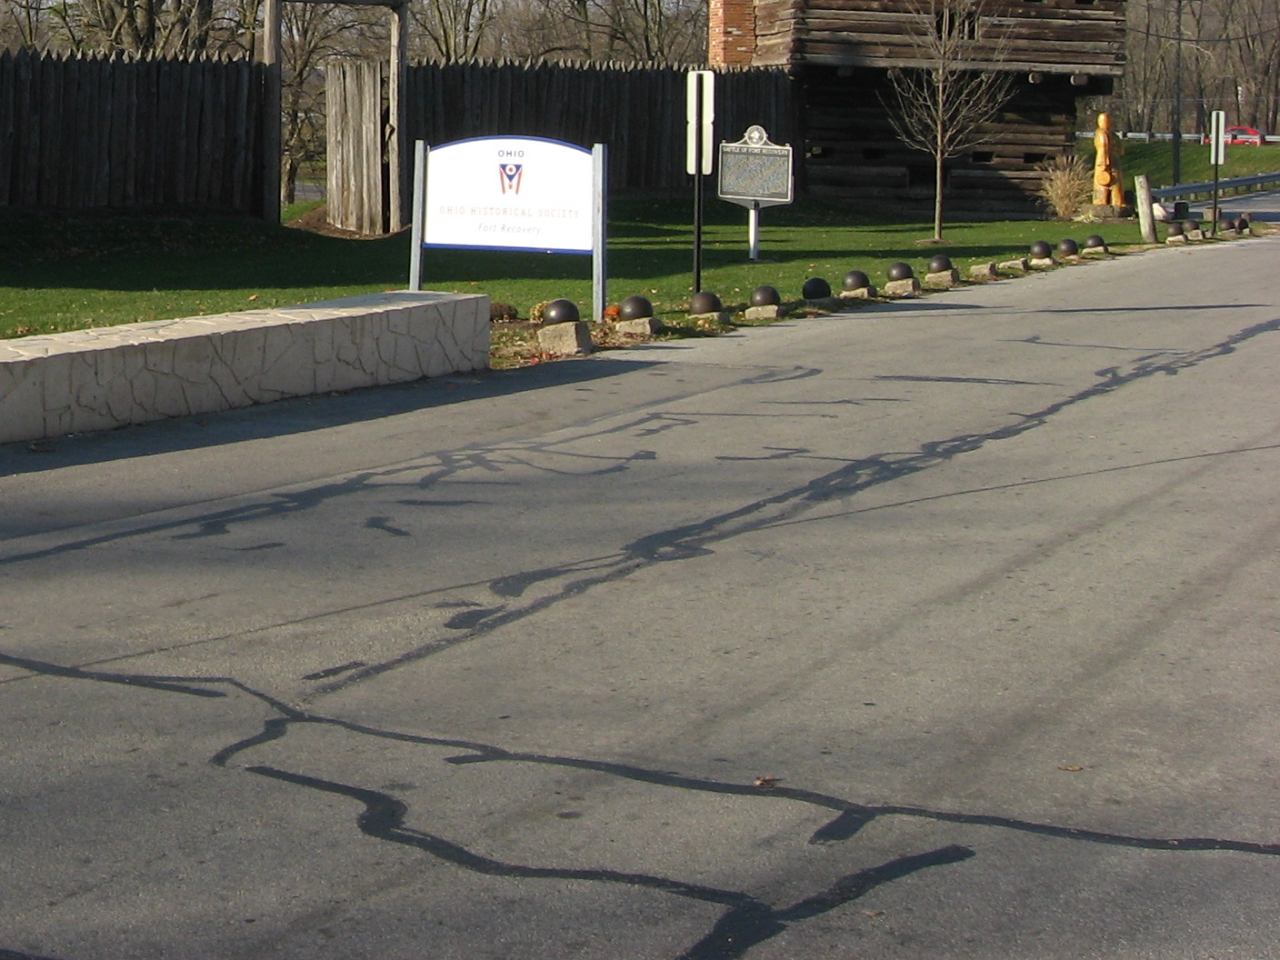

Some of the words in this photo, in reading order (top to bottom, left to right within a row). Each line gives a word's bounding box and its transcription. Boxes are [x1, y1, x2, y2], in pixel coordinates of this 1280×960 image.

[498, 150, 524, 158] OHIO
[439, 205, 465, 216] OHIO
[470, 206, 533, 218] HISTORICAL
[538, 208, 580, 219] SOCIETY
[477, 222, 497, 233] Fort
[501, 223, 541, 236] Recovery
